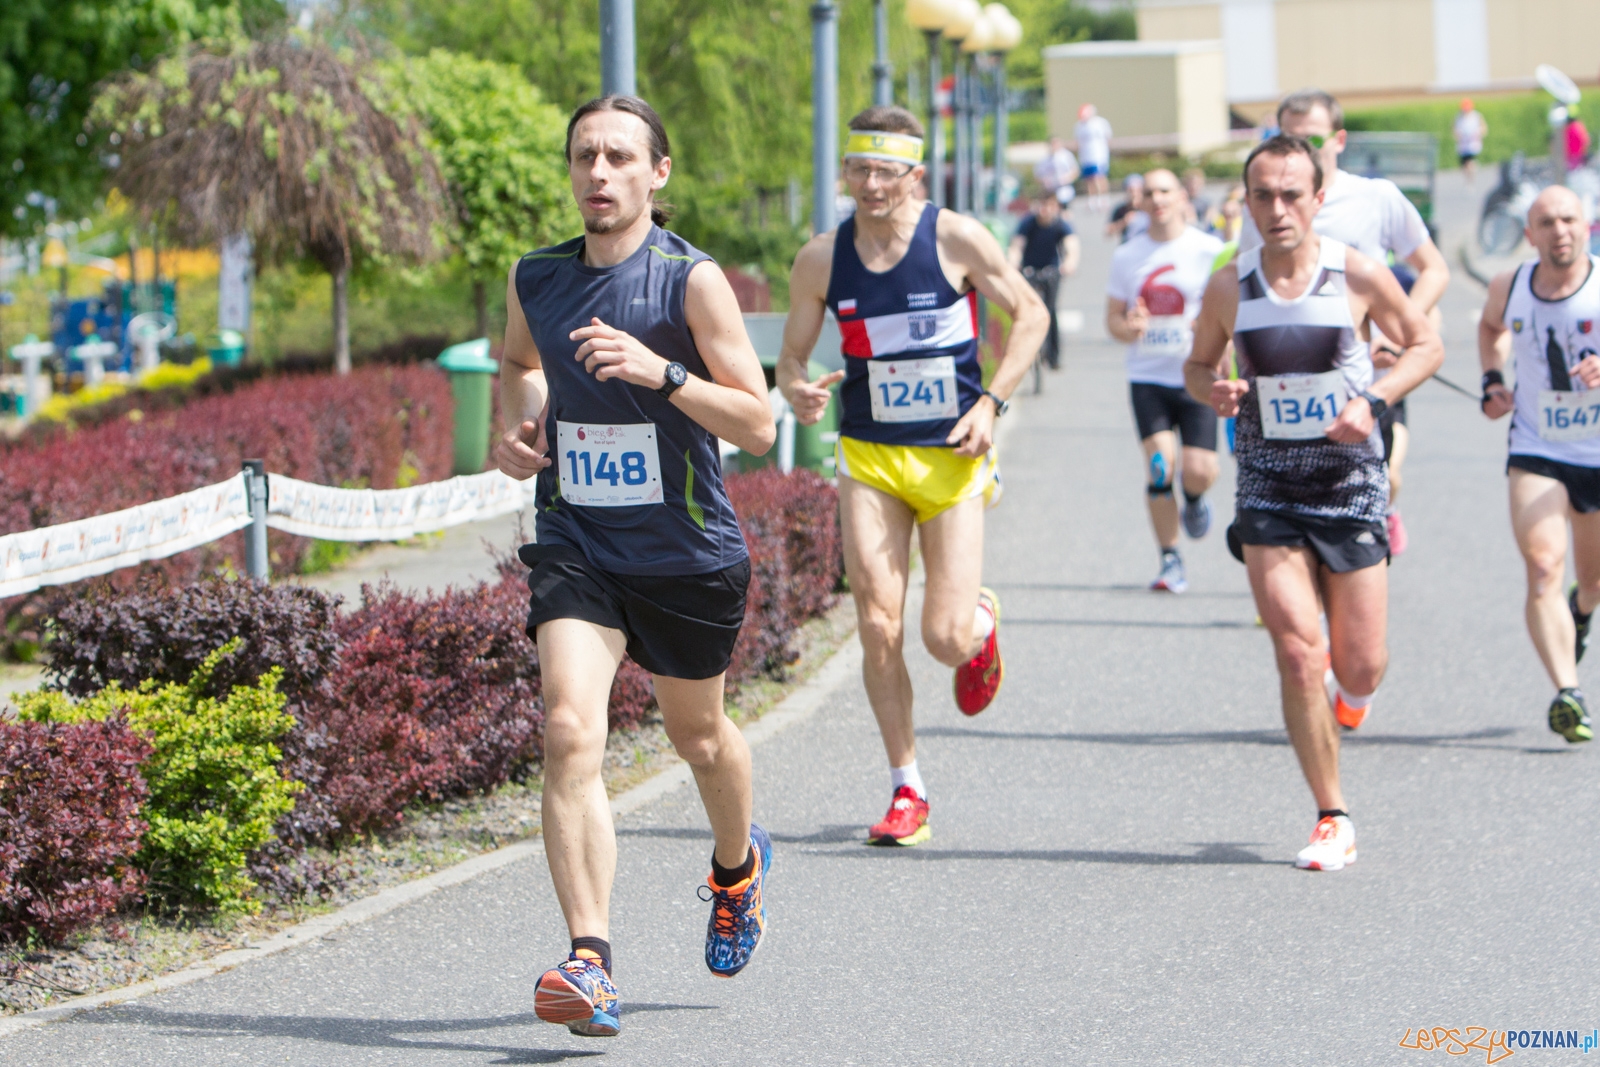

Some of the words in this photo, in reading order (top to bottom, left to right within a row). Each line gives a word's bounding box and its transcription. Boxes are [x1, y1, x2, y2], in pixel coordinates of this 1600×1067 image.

[878, 379, 946, 408] 1241
[1270, 392, 1338, 424] 1341
[1543, 403, 1600, 429] 1647
[566, 449, 648, 487] 1148
